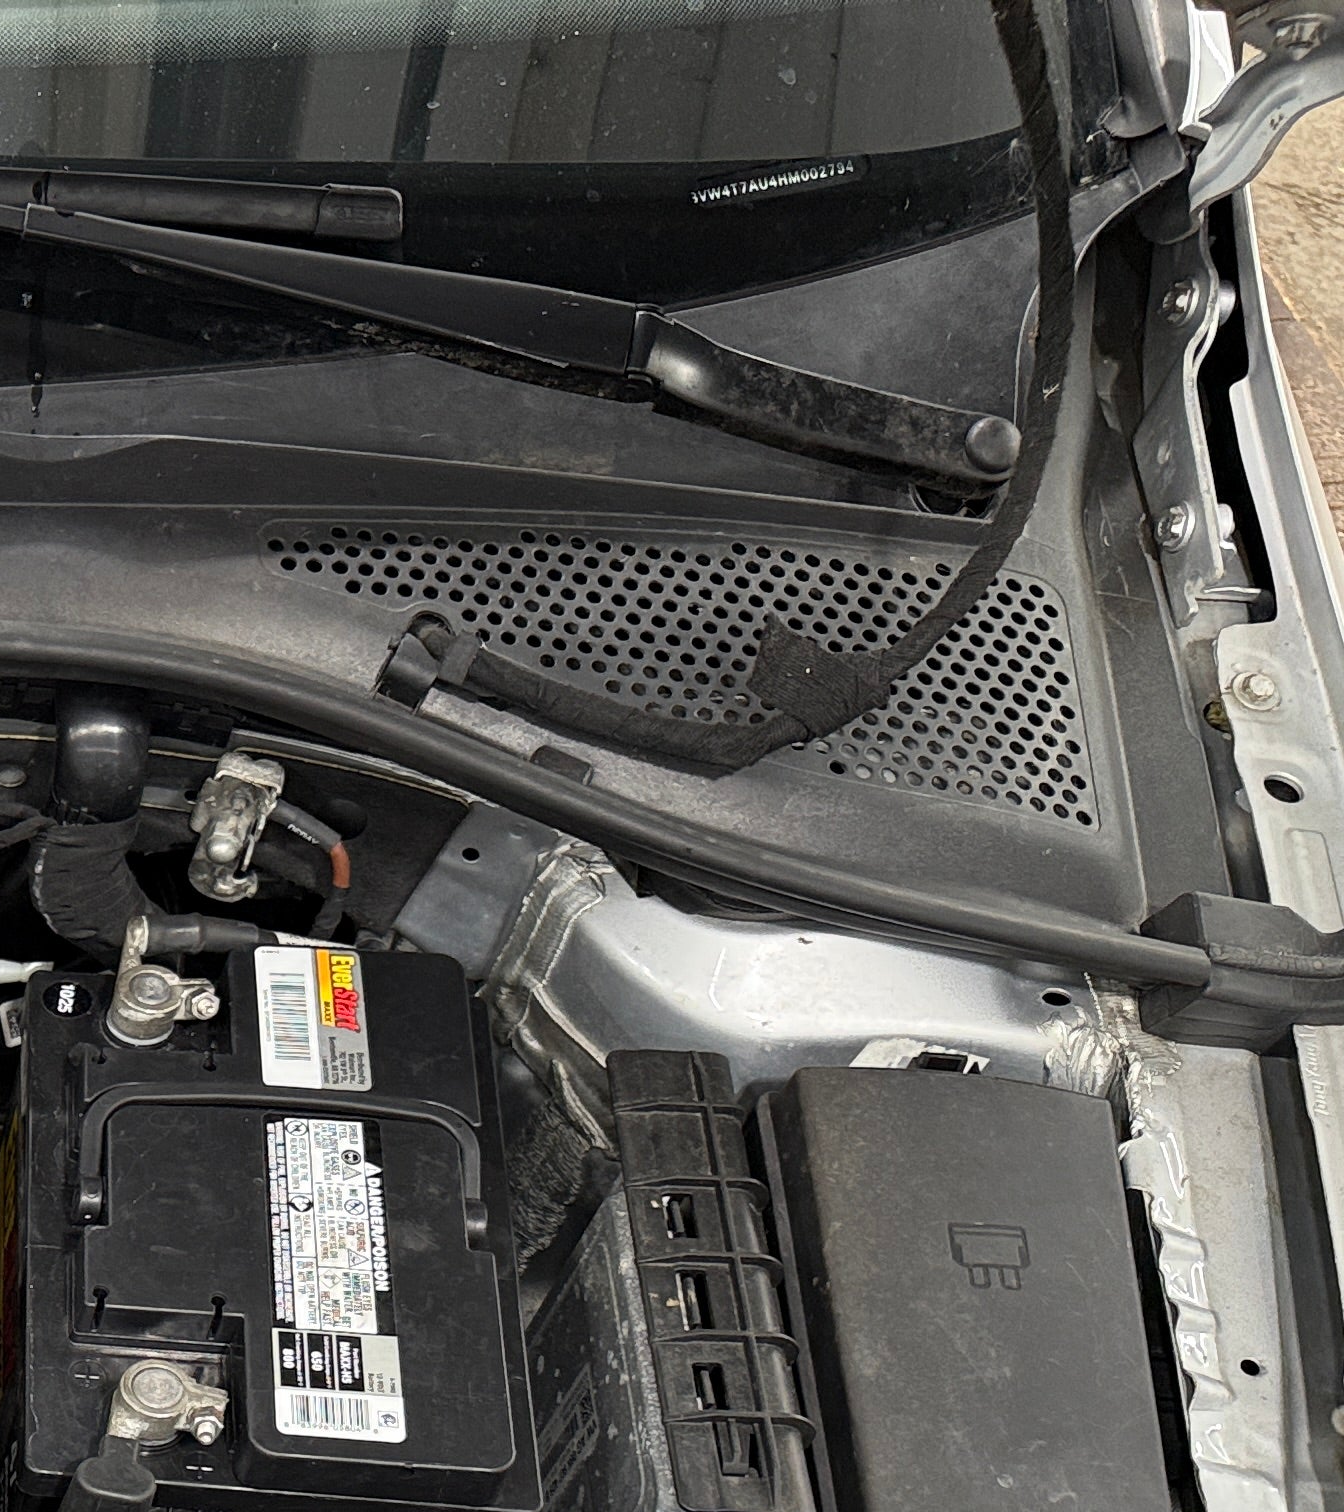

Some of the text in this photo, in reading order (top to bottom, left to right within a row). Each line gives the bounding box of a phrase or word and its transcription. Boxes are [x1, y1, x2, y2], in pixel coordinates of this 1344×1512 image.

[56, 984, 76, 1014] 10/25
[330, 955, 360, 1033] EverStart
[368, 1177, 388, 1291] DANGER/POISON
[310, 1351, 322, 1371] 650
